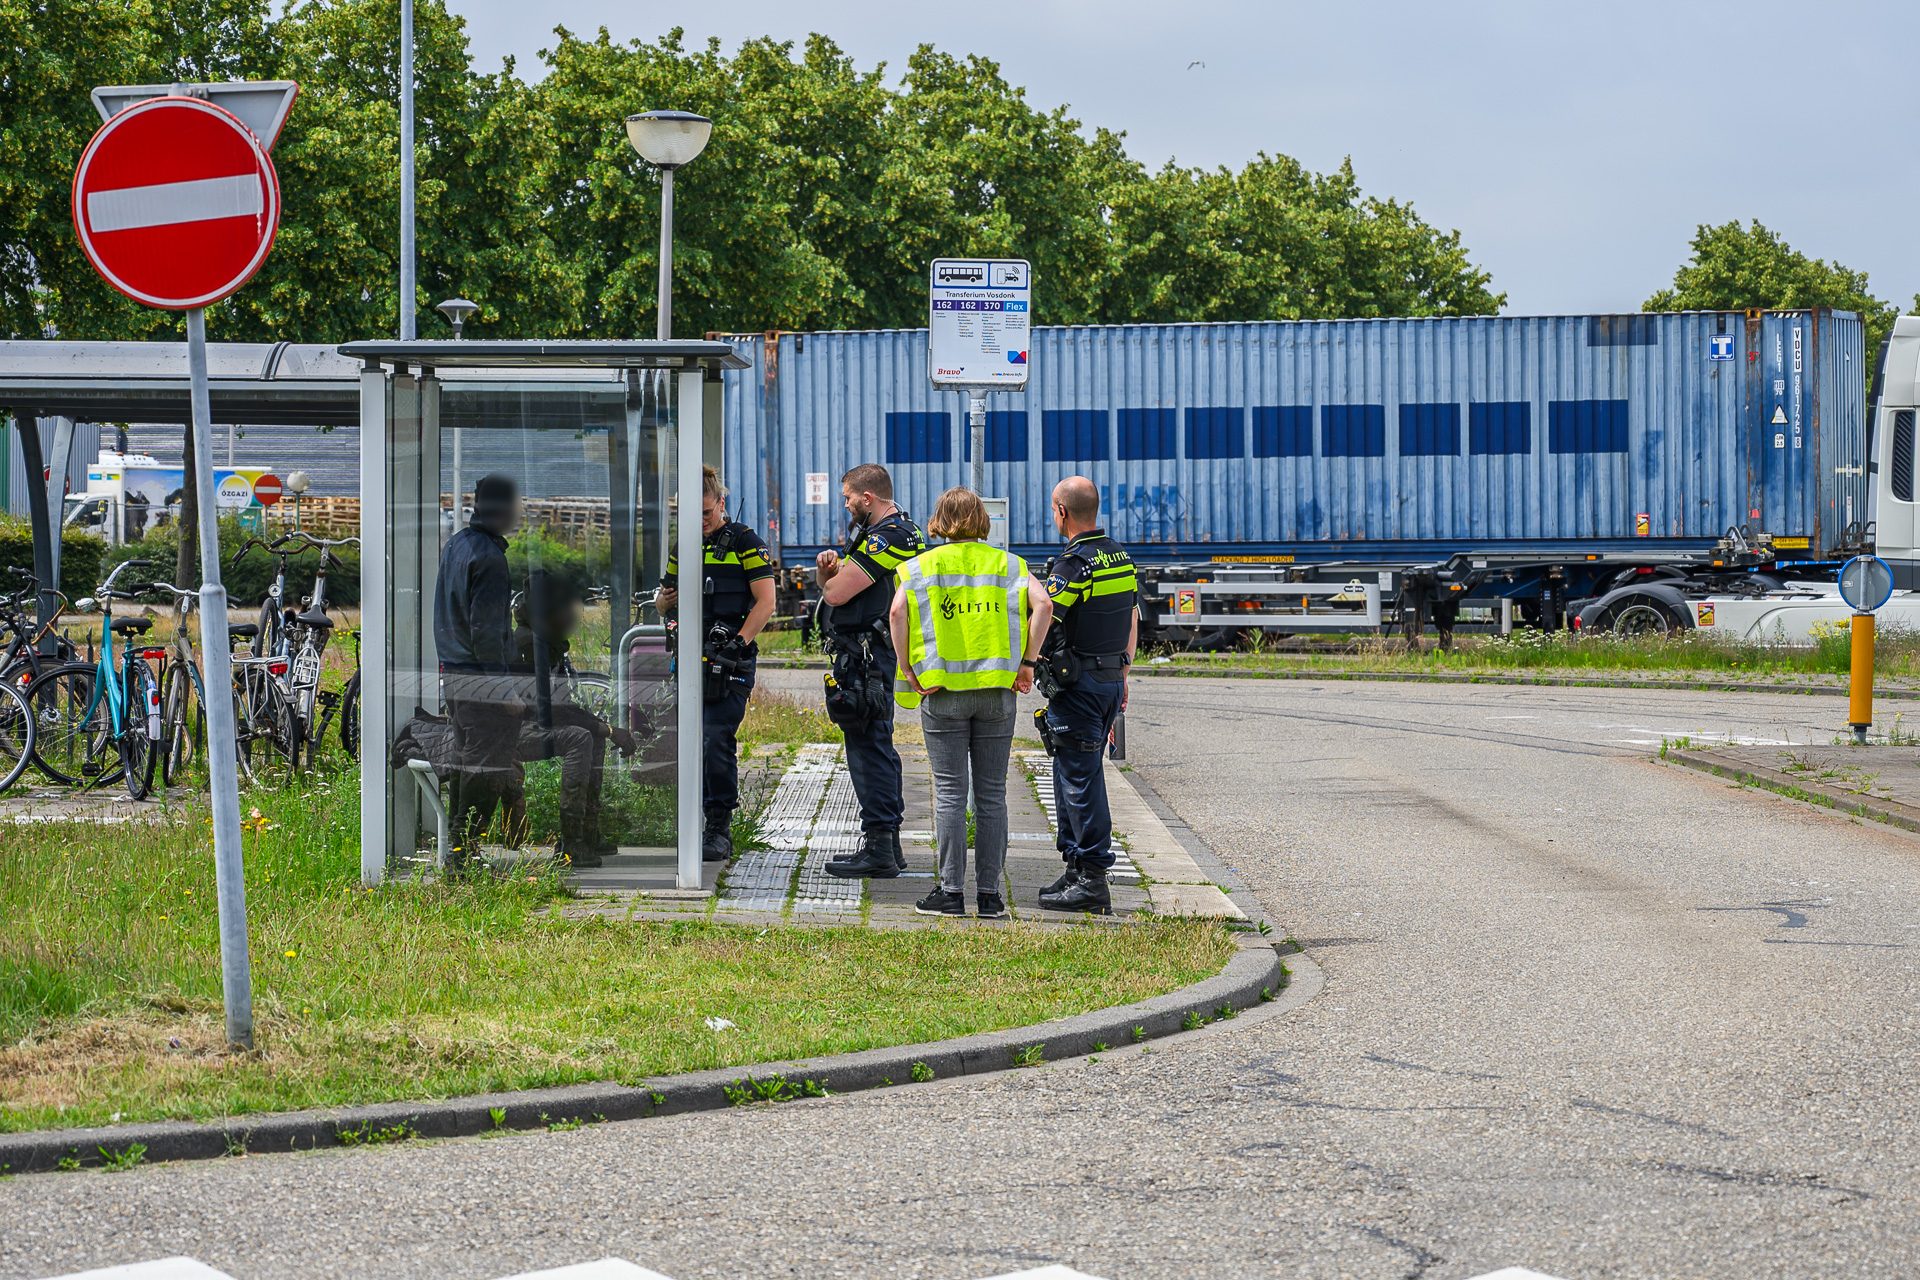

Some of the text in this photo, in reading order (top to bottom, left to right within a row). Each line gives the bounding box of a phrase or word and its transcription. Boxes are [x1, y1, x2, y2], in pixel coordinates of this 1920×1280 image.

[936, 301, 1024, 311] 162 162 370 Flex
[937, 368, 961, 376] Bravo
